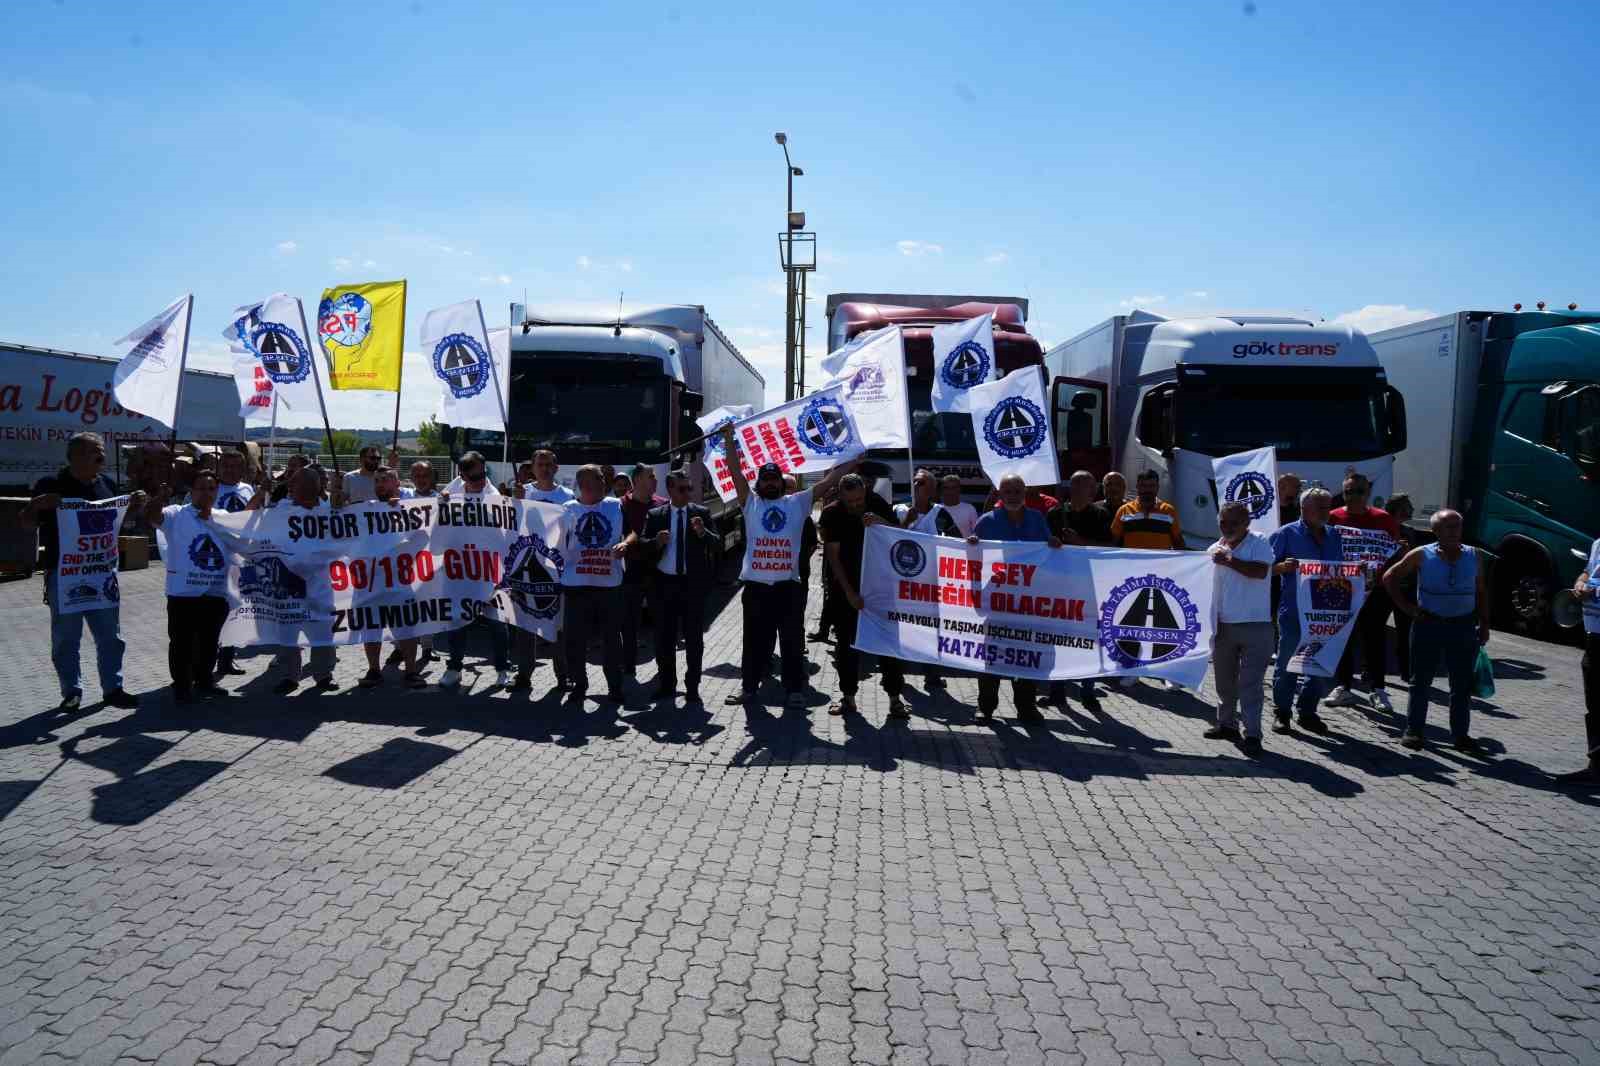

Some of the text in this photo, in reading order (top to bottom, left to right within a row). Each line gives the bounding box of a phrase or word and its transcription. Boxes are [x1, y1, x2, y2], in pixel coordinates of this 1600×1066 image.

[742, 426, 767, 469] OLAC
[288, 498, 519, 543] ŞOFÖR TURİST DEĞİLDİR
[329, 550, 434, 592] 90/180
[444, 543, 500, 585] GÜN
[938, 556, 983, 582] HER
[990, 562, 1038, 588] ŞEY
[331, 597, 453, 634] ZULMÜNE
[898, 579, 1086, 622] EMEĞİN OLACAK
[887, 611, 940, 629] KARAYOLU
[943, 618, 985, 635] TAŞIMA
[1035, 631, 1095, 650] SENDİKASI
[938, 636, 1043, 670] KATAŞ-SEN
